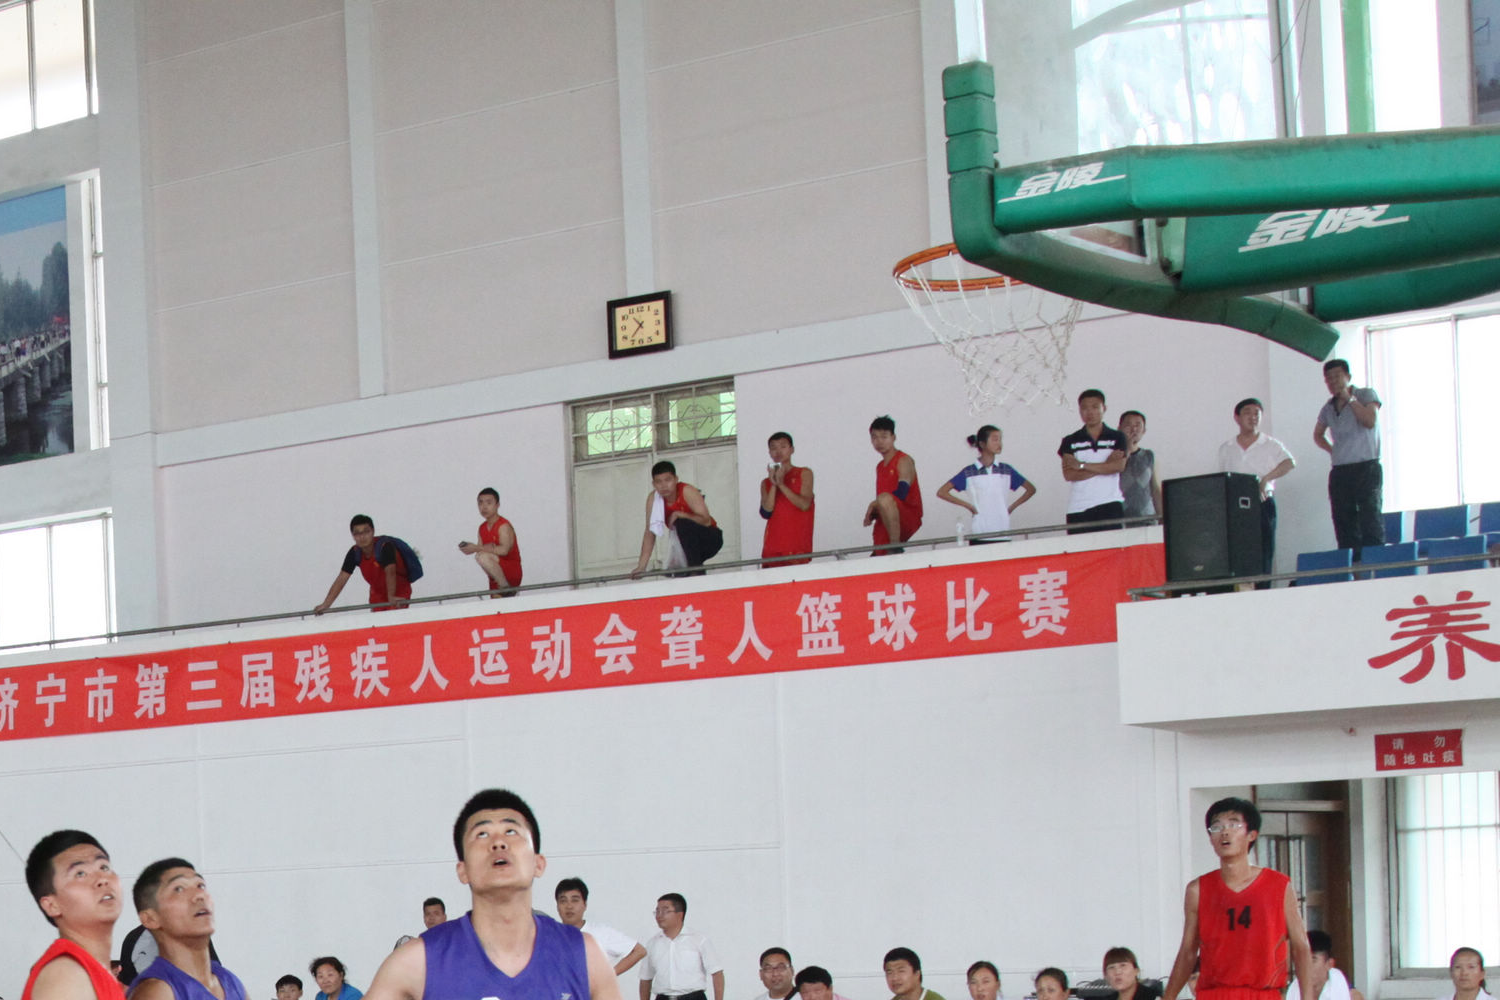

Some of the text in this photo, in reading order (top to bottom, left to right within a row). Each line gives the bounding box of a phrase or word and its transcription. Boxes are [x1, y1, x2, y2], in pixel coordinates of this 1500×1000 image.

[997, 161, 1127, 204] 金陵
[1238, 204, 1410, 253] 金陵
[1367, 590, 1500, 684] 养
[1226, 905, 1252, 931] 14
